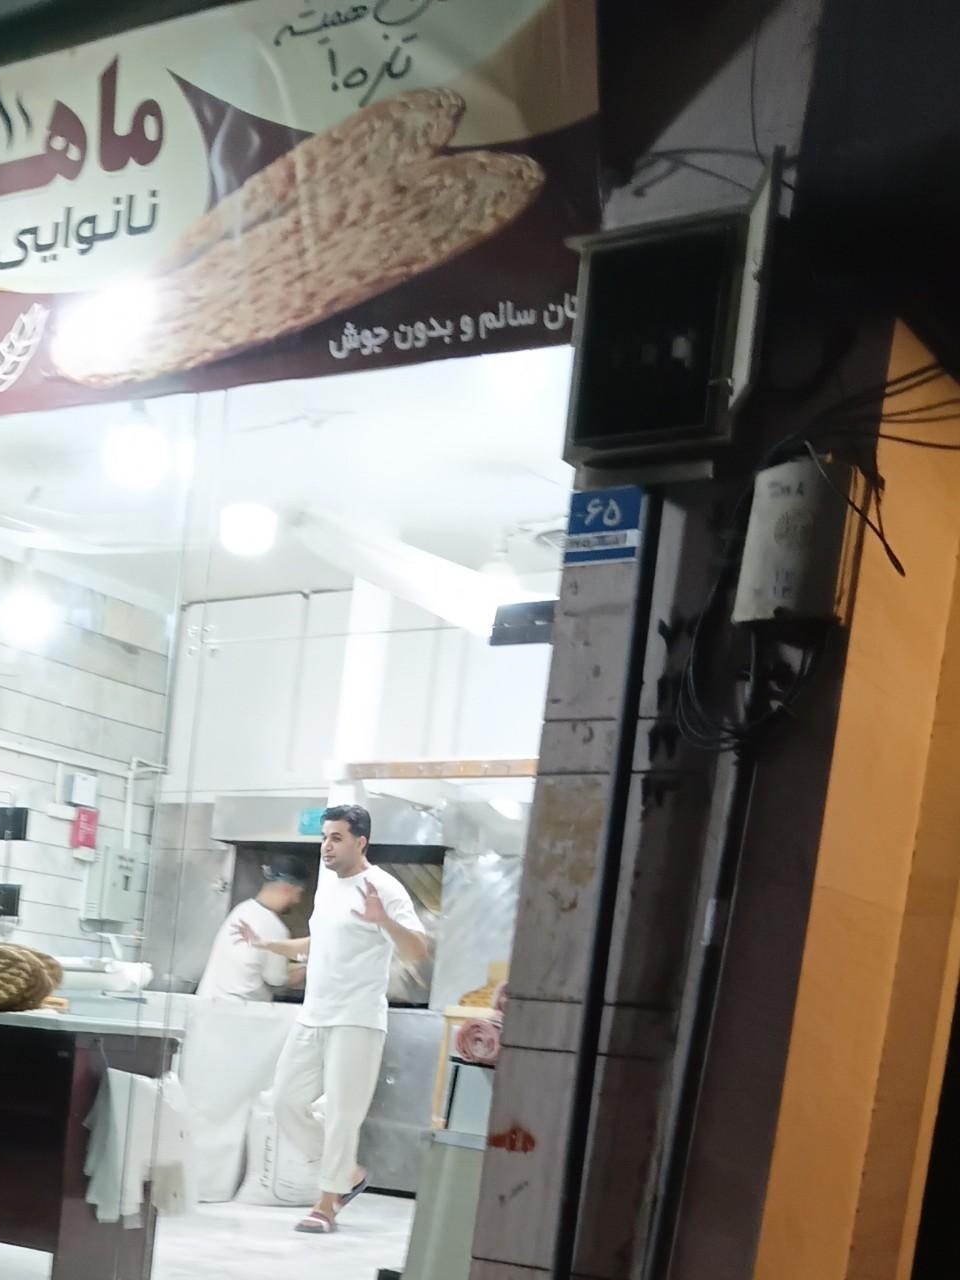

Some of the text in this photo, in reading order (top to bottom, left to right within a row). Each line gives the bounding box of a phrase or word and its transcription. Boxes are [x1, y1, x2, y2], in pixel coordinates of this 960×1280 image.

[393, 316, 454, 350] بدون
[460, 314, 475, 342] و
[479, 300, 537, 340] سالم
[328, 321, 390, 360] جوش
[584, 498, 621, 528] ۶۵
